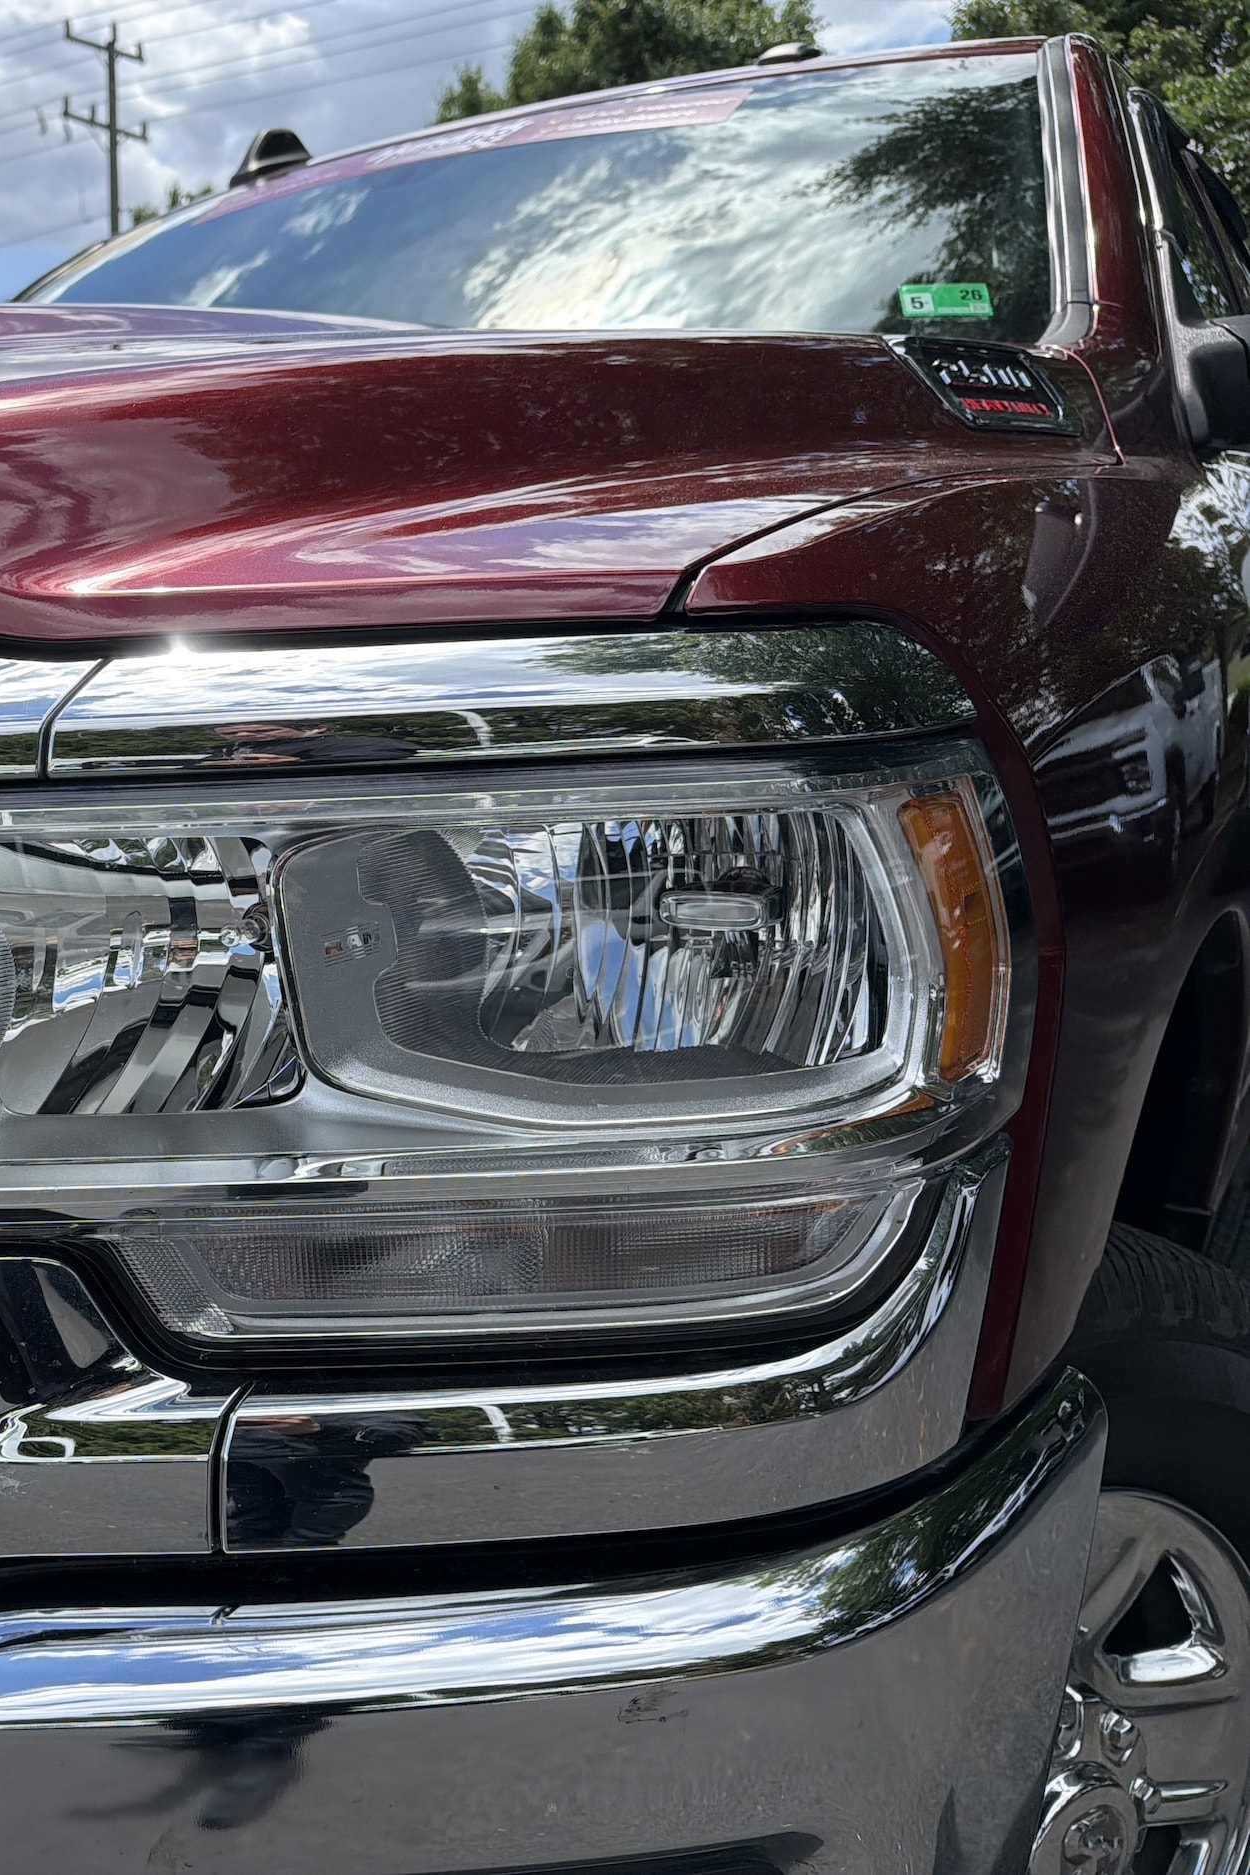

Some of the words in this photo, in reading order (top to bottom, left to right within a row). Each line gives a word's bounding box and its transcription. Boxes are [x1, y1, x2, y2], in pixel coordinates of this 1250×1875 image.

[910, 296, 924, 310] 5
[959, 289, 983, 302] 26
[958, 397, 1013, 413] HEAVY
[323, 929, 380, 956] RAM
